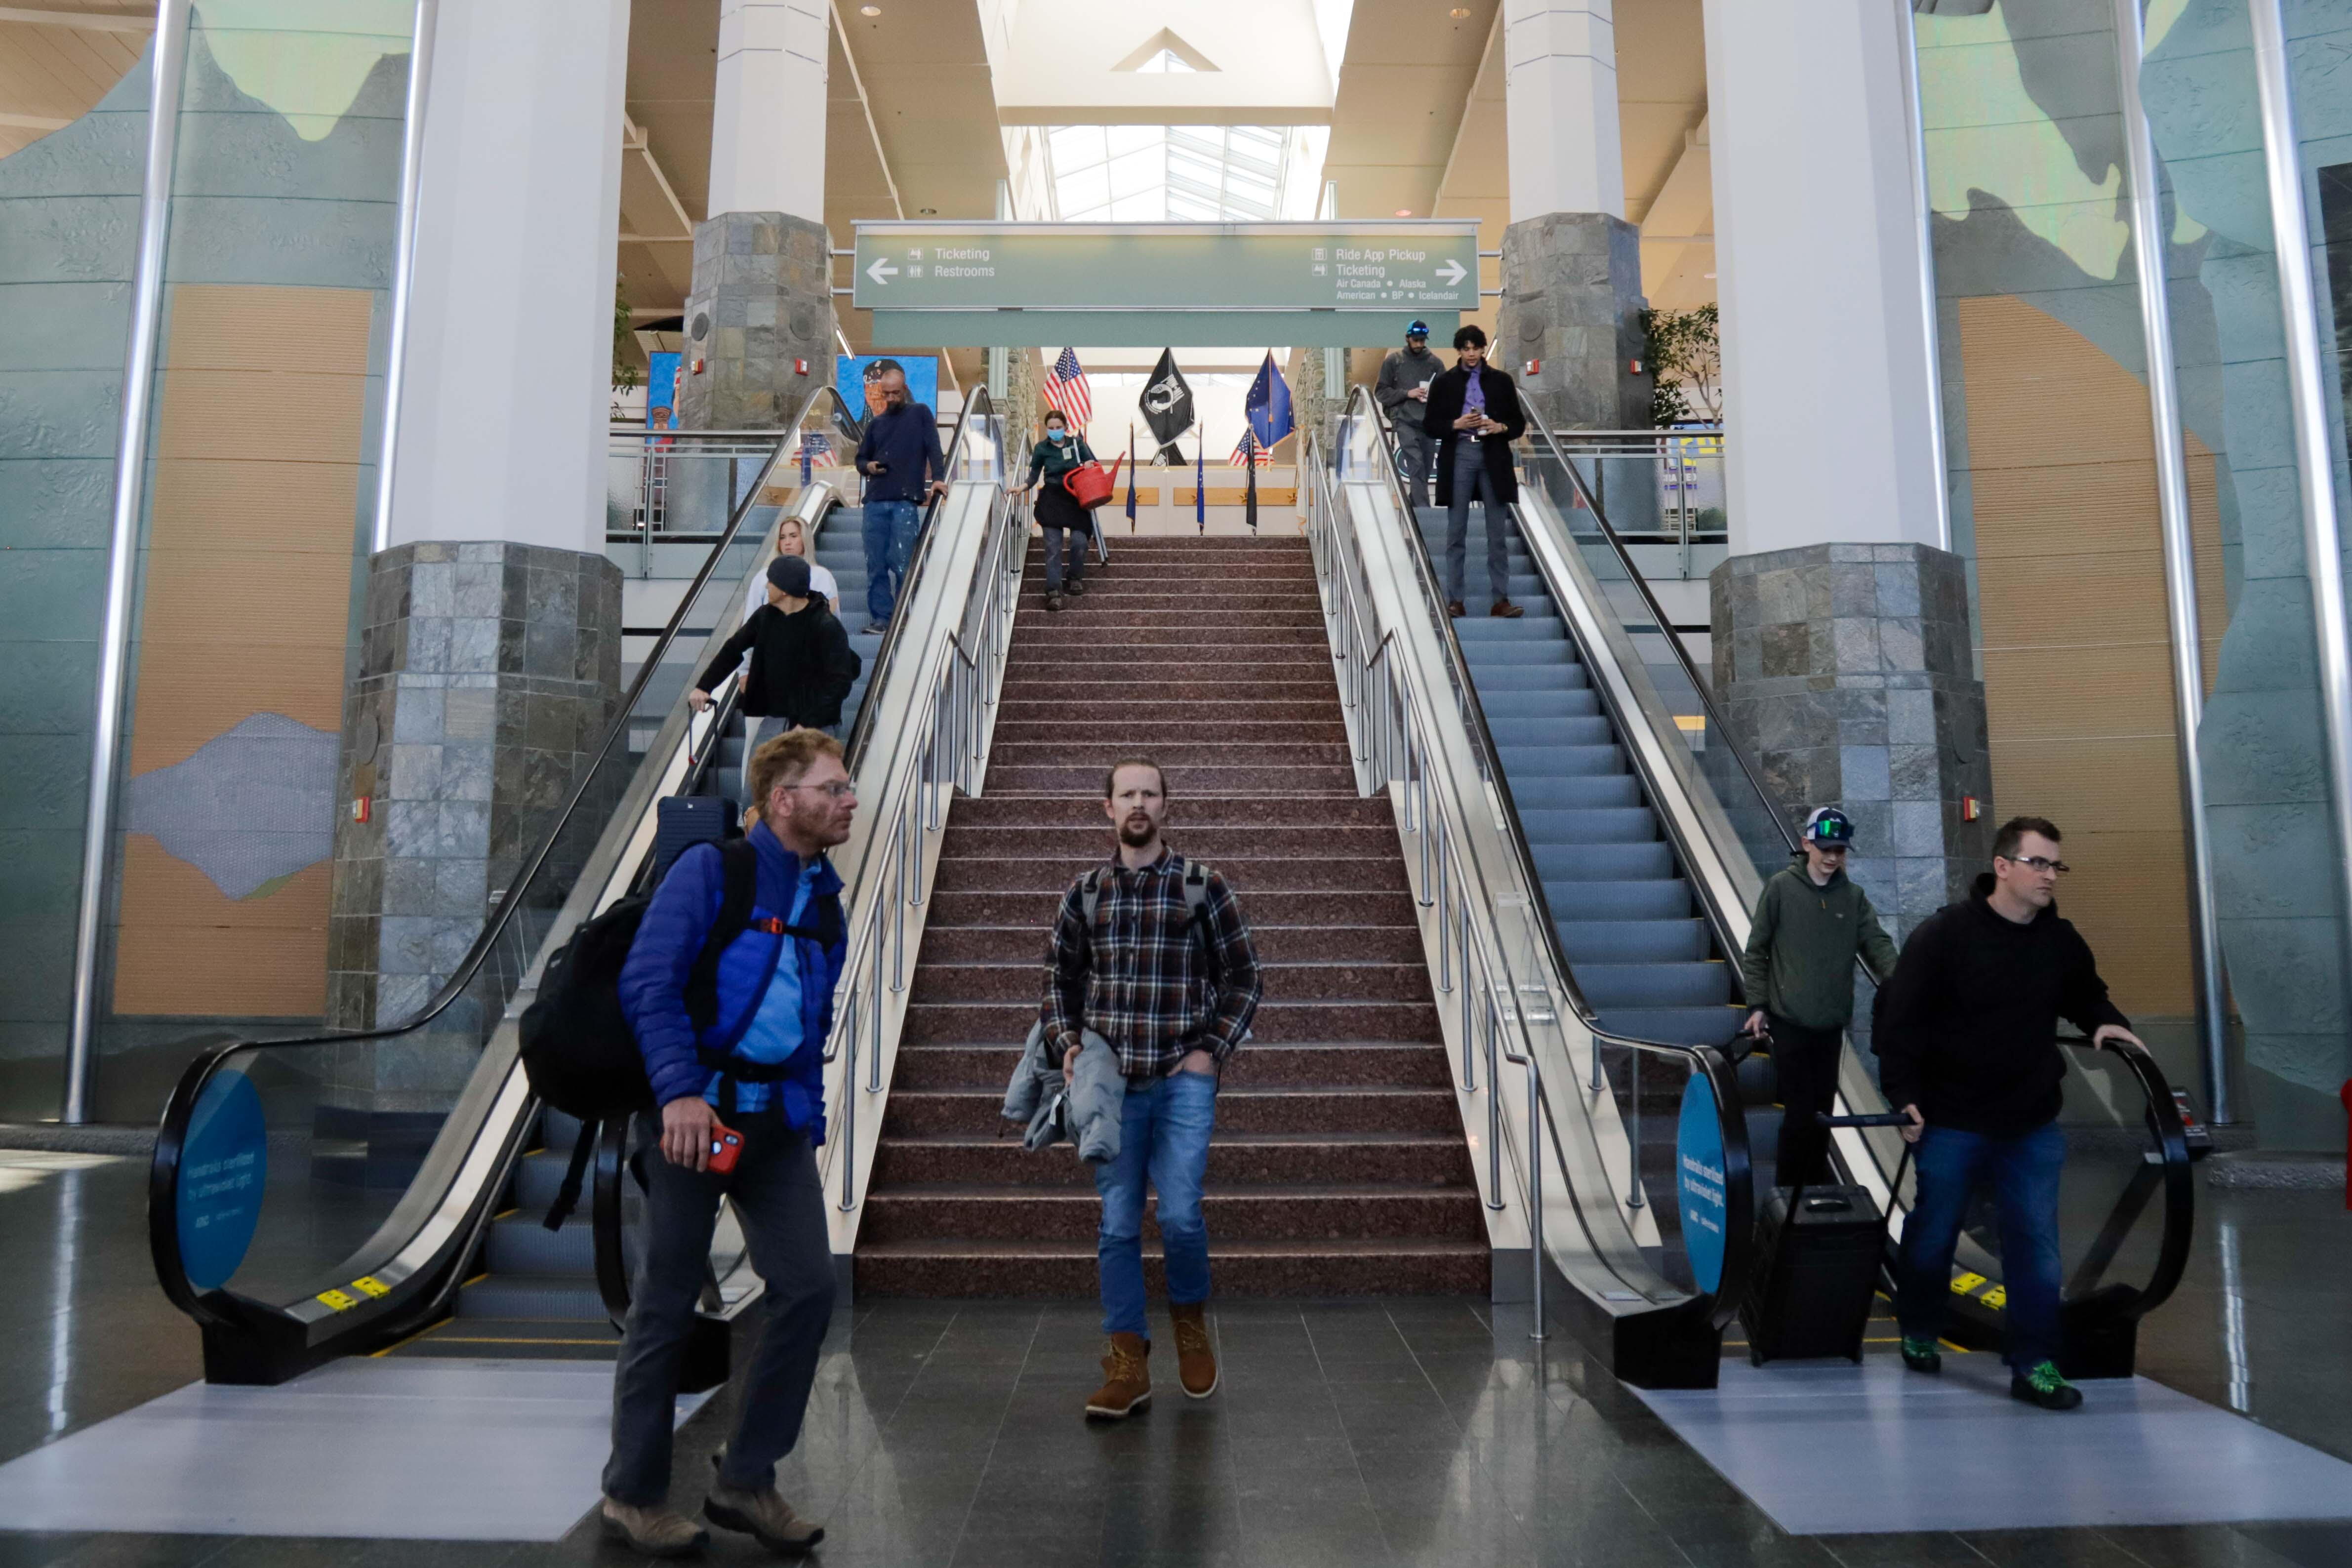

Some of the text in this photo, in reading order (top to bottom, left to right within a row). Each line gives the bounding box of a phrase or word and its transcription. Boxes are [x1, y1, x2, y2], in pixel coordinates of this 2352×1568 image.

[935, 248, 990, 261] Ticketing
[1336, 248, 1426, 263] Ride App Pickup
[935, 265, 995, 277] Restrooms
[1336, 264, 1385, 278] Ticketing
[1336, 279, 1426, 288] Air Canada Alaska
[1337, 291, 1459, 300] American BP Icelandair
